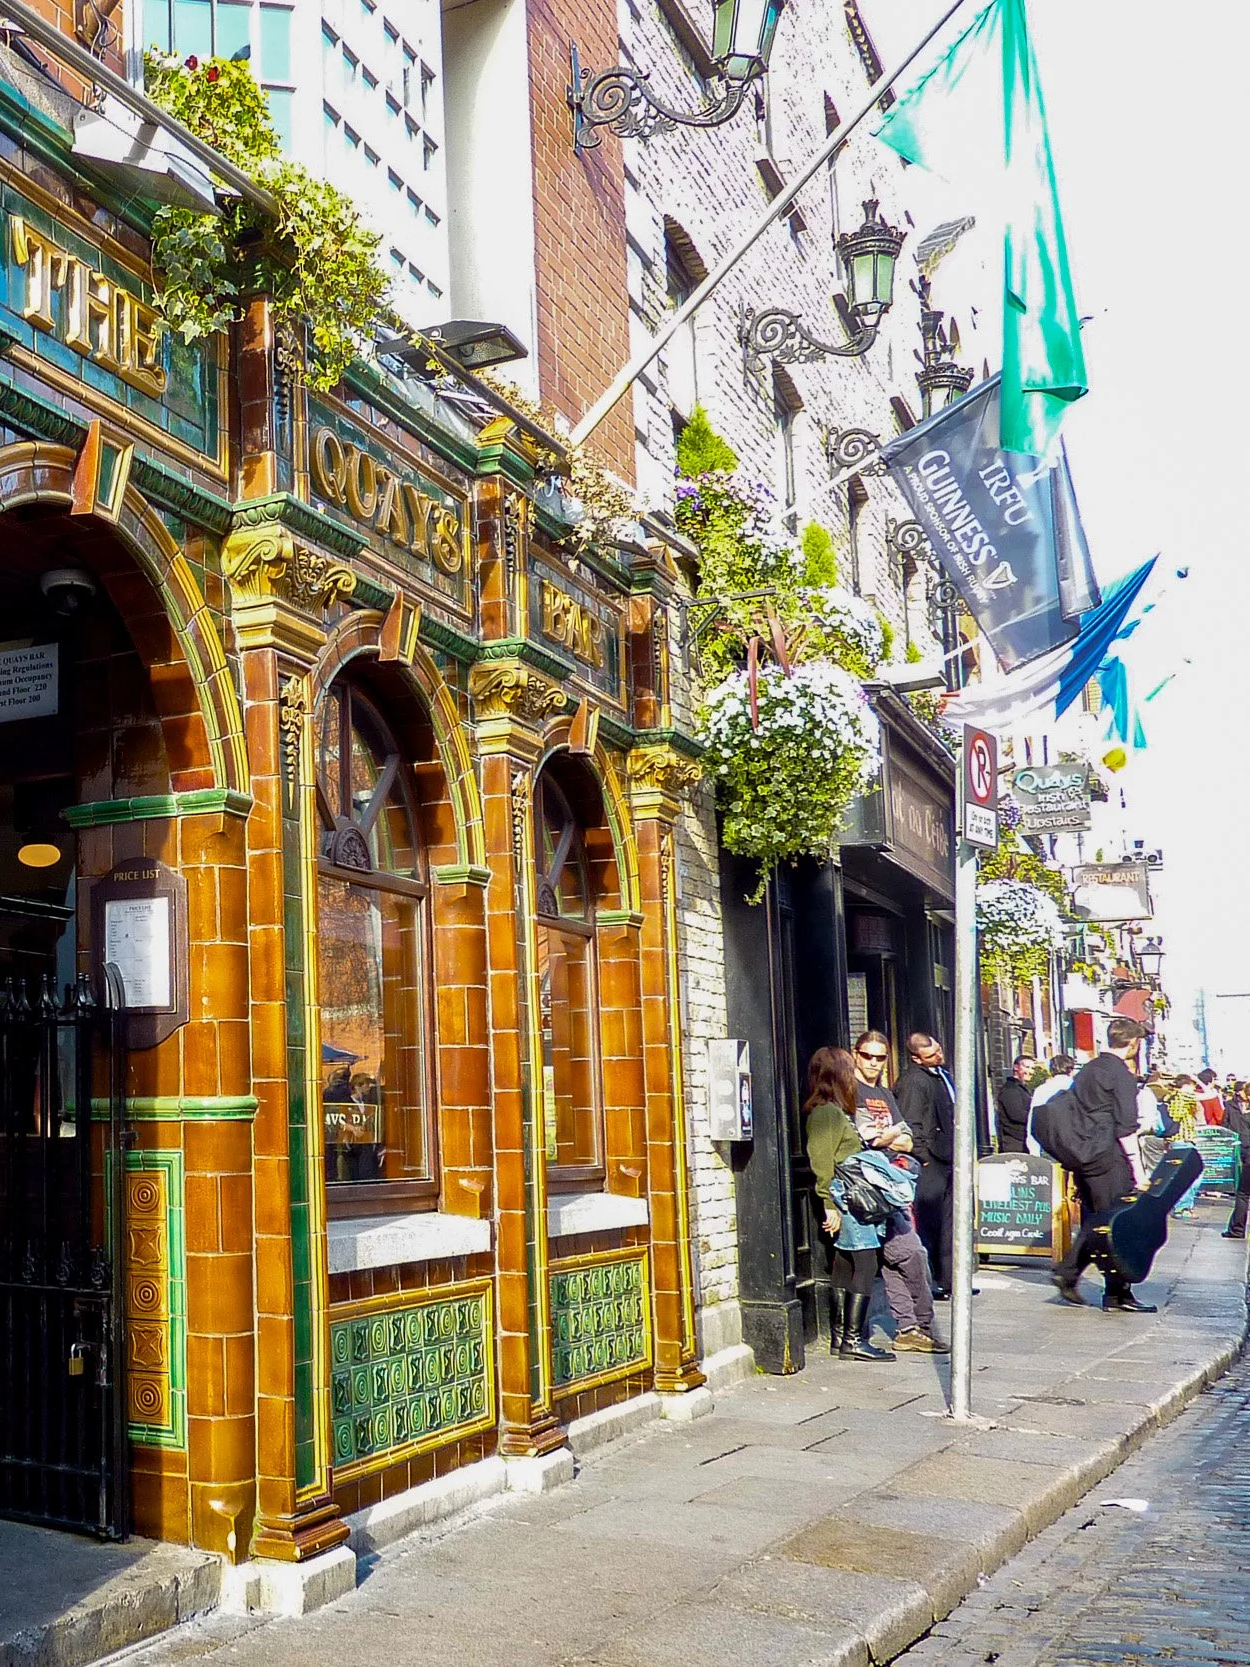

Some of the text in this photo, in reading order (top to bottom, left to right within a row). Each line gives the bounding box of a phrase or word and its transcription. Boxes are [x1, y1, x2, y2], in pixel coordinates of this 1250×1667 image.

[10, 215, 168, 399] THE
[978, 459, 1032, 526] IRFU
[309, 425, 463, 575] QUAYS
[918, 449, 998, 566] GUINNESS
[902, 465, 913, 475] A
[909, 471, 930, 503] PROUD
[924, 502, 951, 546] SPONSOR
[946, 540, 960, 554] OF
[953, 551, 972, 576] IRISH
[542, 579, 604, 672] BAR
[2, 655, 28, 666] QUAYS
[29, 651, 45, 661] BAR
[12, 661, 54, 675] Regulations
[14, 672, 53, 684] Occupancy
[12, 685, 31, 696] Floor
[34, 682, 48, 693] 220
[8, 696, 27, 707] Floor
[1026, 815, 1080, 829] Upstairs
[113, 869, 161, 882] PRICE LIST
[1082, 871, 1140, 884] RESTAURANT
[1030, 1175, 1050, 1186] BAR
[980, 1211, 1044, 1225] MUSIC DAILY
